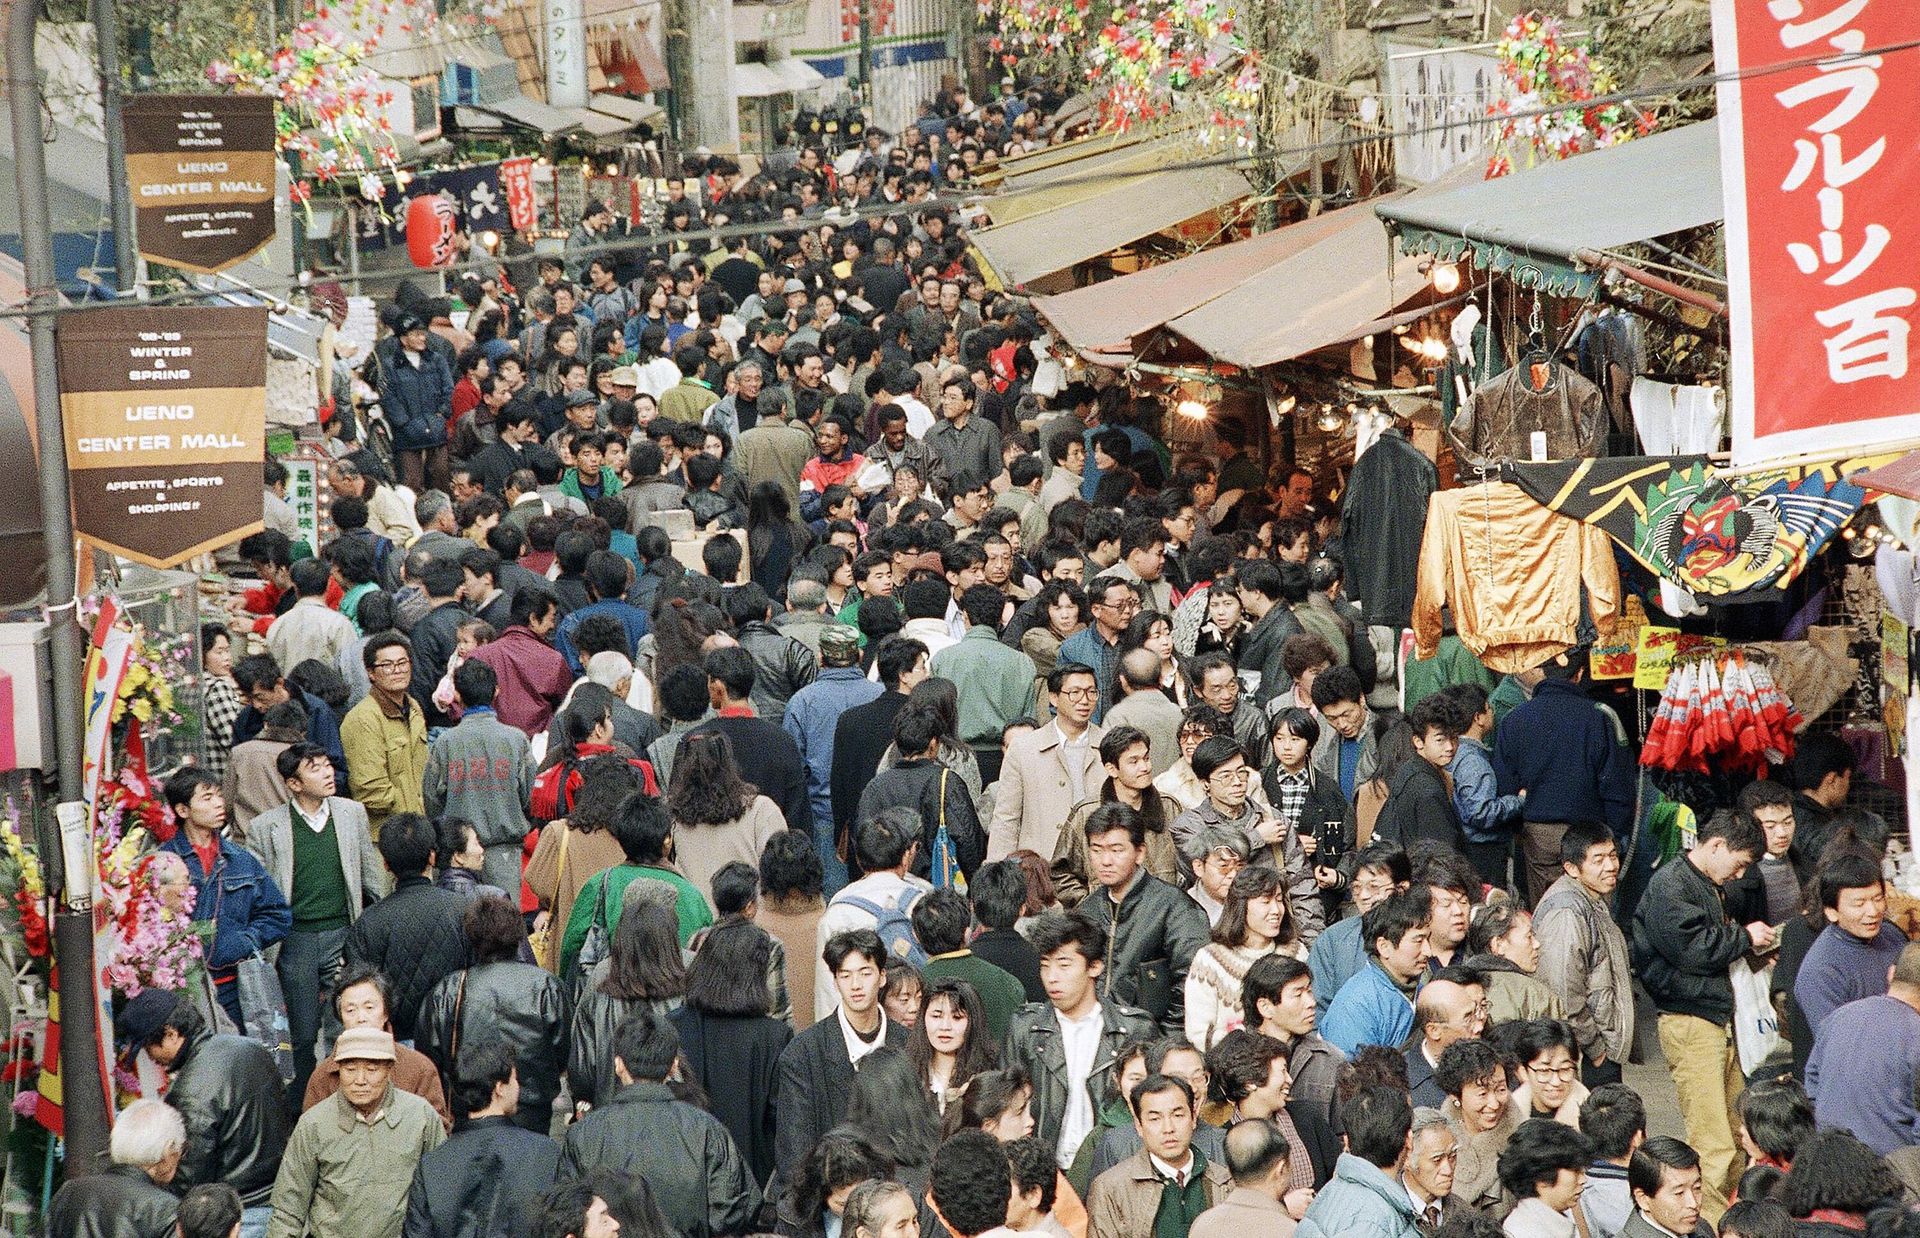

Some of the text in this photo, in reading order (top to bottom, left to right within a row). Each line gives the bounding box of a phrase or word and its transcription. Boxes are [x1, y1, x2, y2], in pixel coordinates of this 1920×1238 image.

[177, 122, 223, 130] WINTER
[178, 138, 223, 146] SPRING
[177, 162, 228, 174] UENO
[140, 181, 267, 197] CENTER MALL
[432, 201, 454, 267] ラーメン
[130, 347, 192, 357] WINTER
[154, 358, 166, 369] &
[129, 369, 191, 381] SPRING
[126, 405, 194, 421] UENO
[77, 433, 246, 453] CENTER MALL
[173, 477, 223, 488] SPORTS
[156, 492, 166, 501] &
